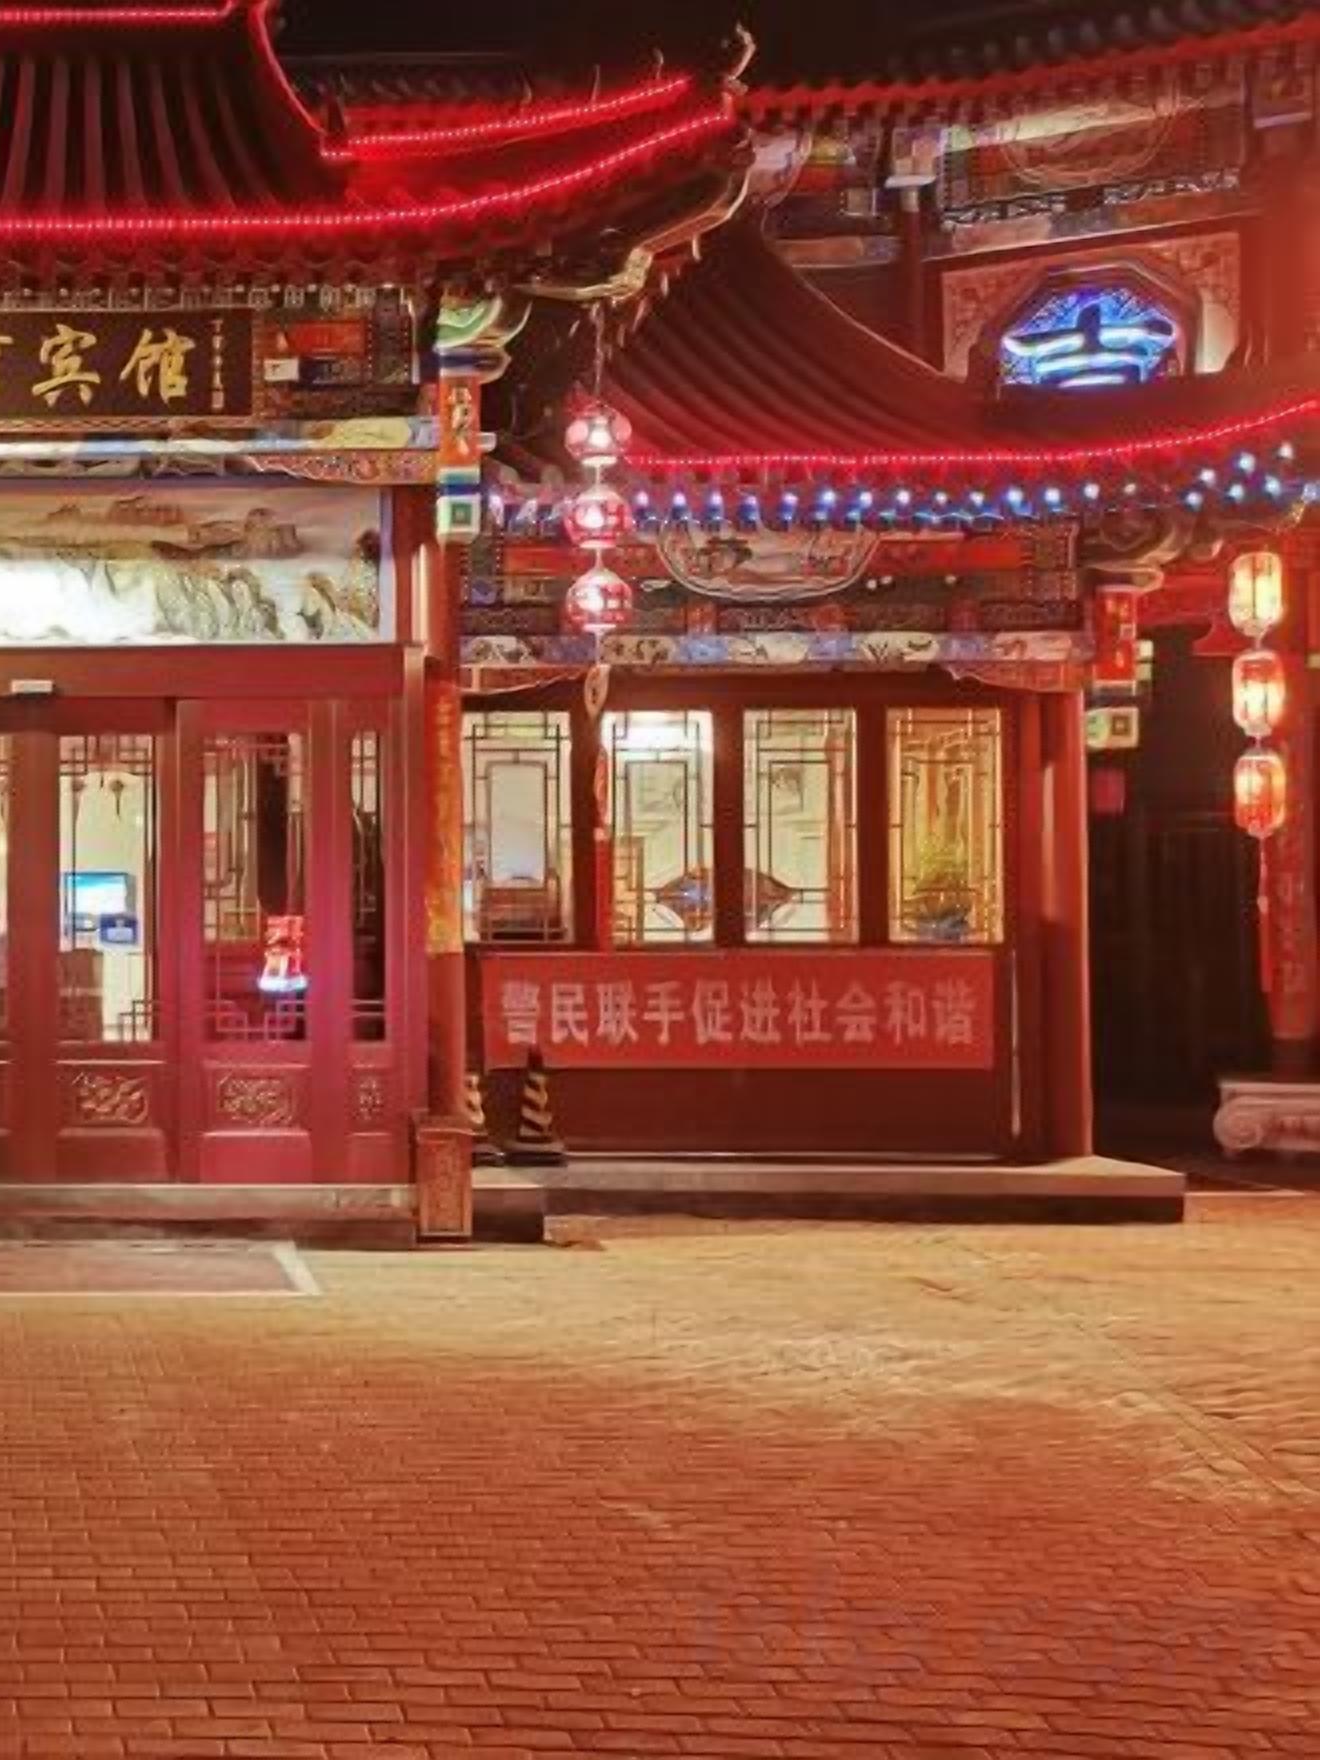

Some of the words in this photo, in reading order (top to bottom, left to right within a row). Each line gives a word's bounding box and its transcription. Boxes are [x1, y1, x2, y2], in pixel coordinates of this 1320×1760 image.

[501, 976, 975, 1046] 警民联手促进社会和谐
